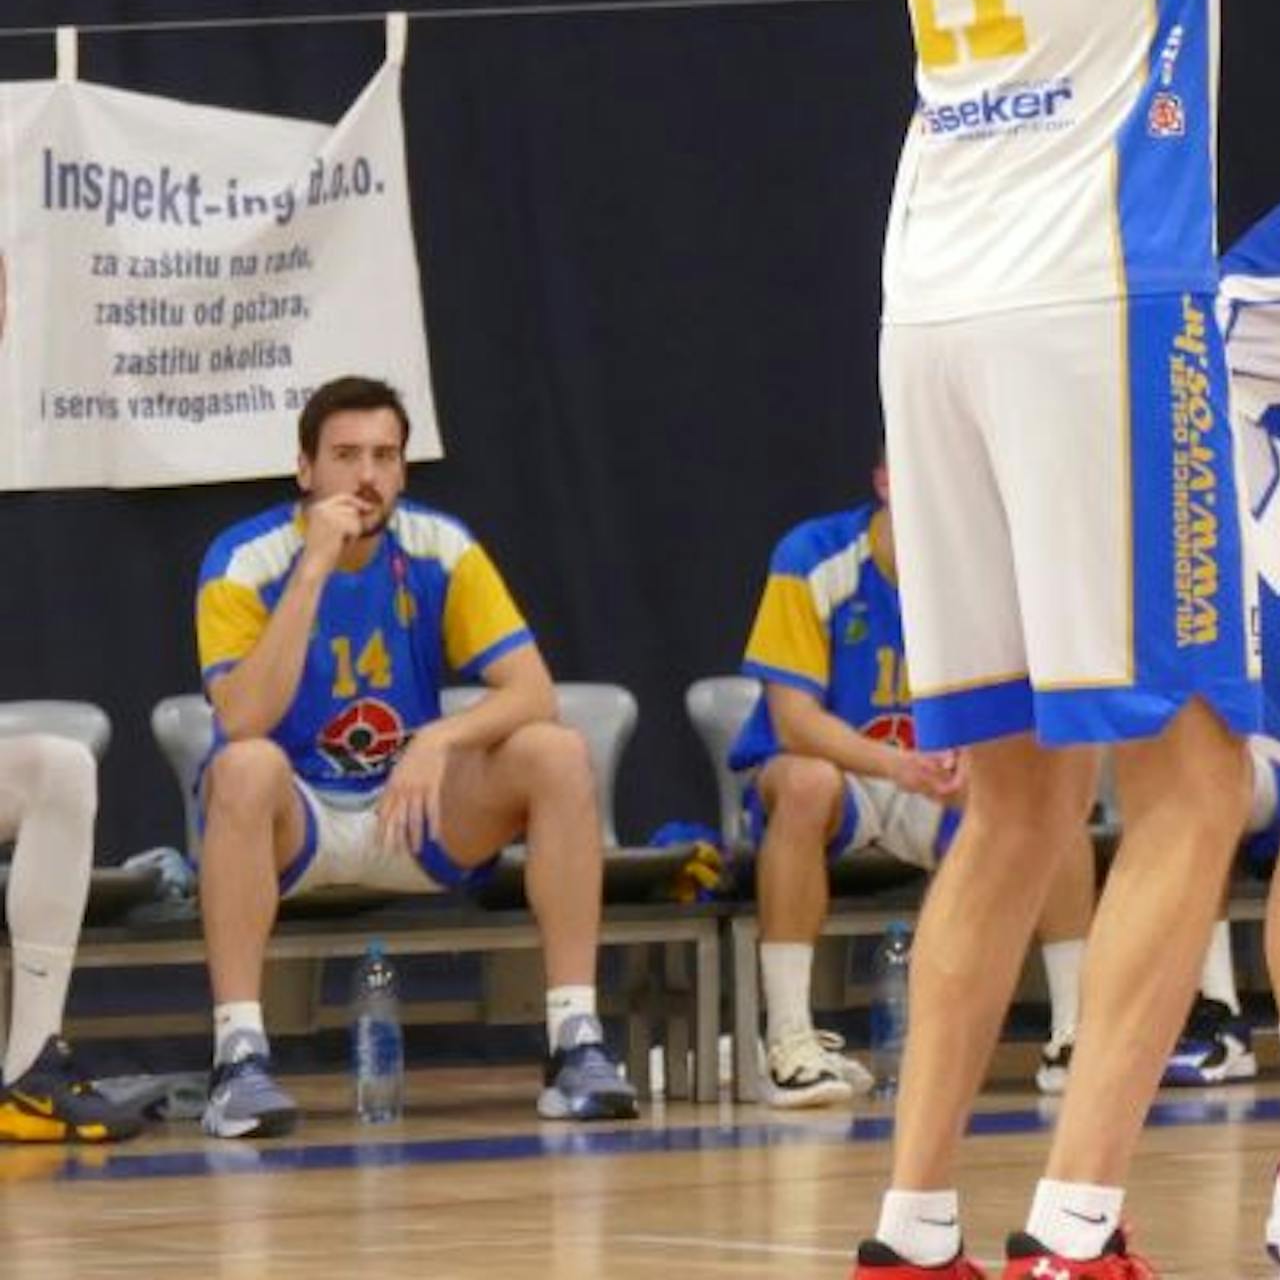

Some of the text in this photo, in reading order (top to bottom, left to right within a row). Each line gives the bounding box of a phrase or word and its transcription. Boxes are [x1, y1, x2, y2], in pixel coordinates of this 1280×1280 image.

[43, 149, 295, 226] Inspekt-ing
[92, 254, 118, 277] za
[128, 249, 221, 279] zaštitu
[229, 254, 258, 277] na
[95, 296, 184, 327] zaštitu
[194, 296, 226, 326] od
[112, 345, 201, 376] zaštitu
[1174, 293, 1219, 645] www.vros.hr
[331, 629, 392, 700] 14
